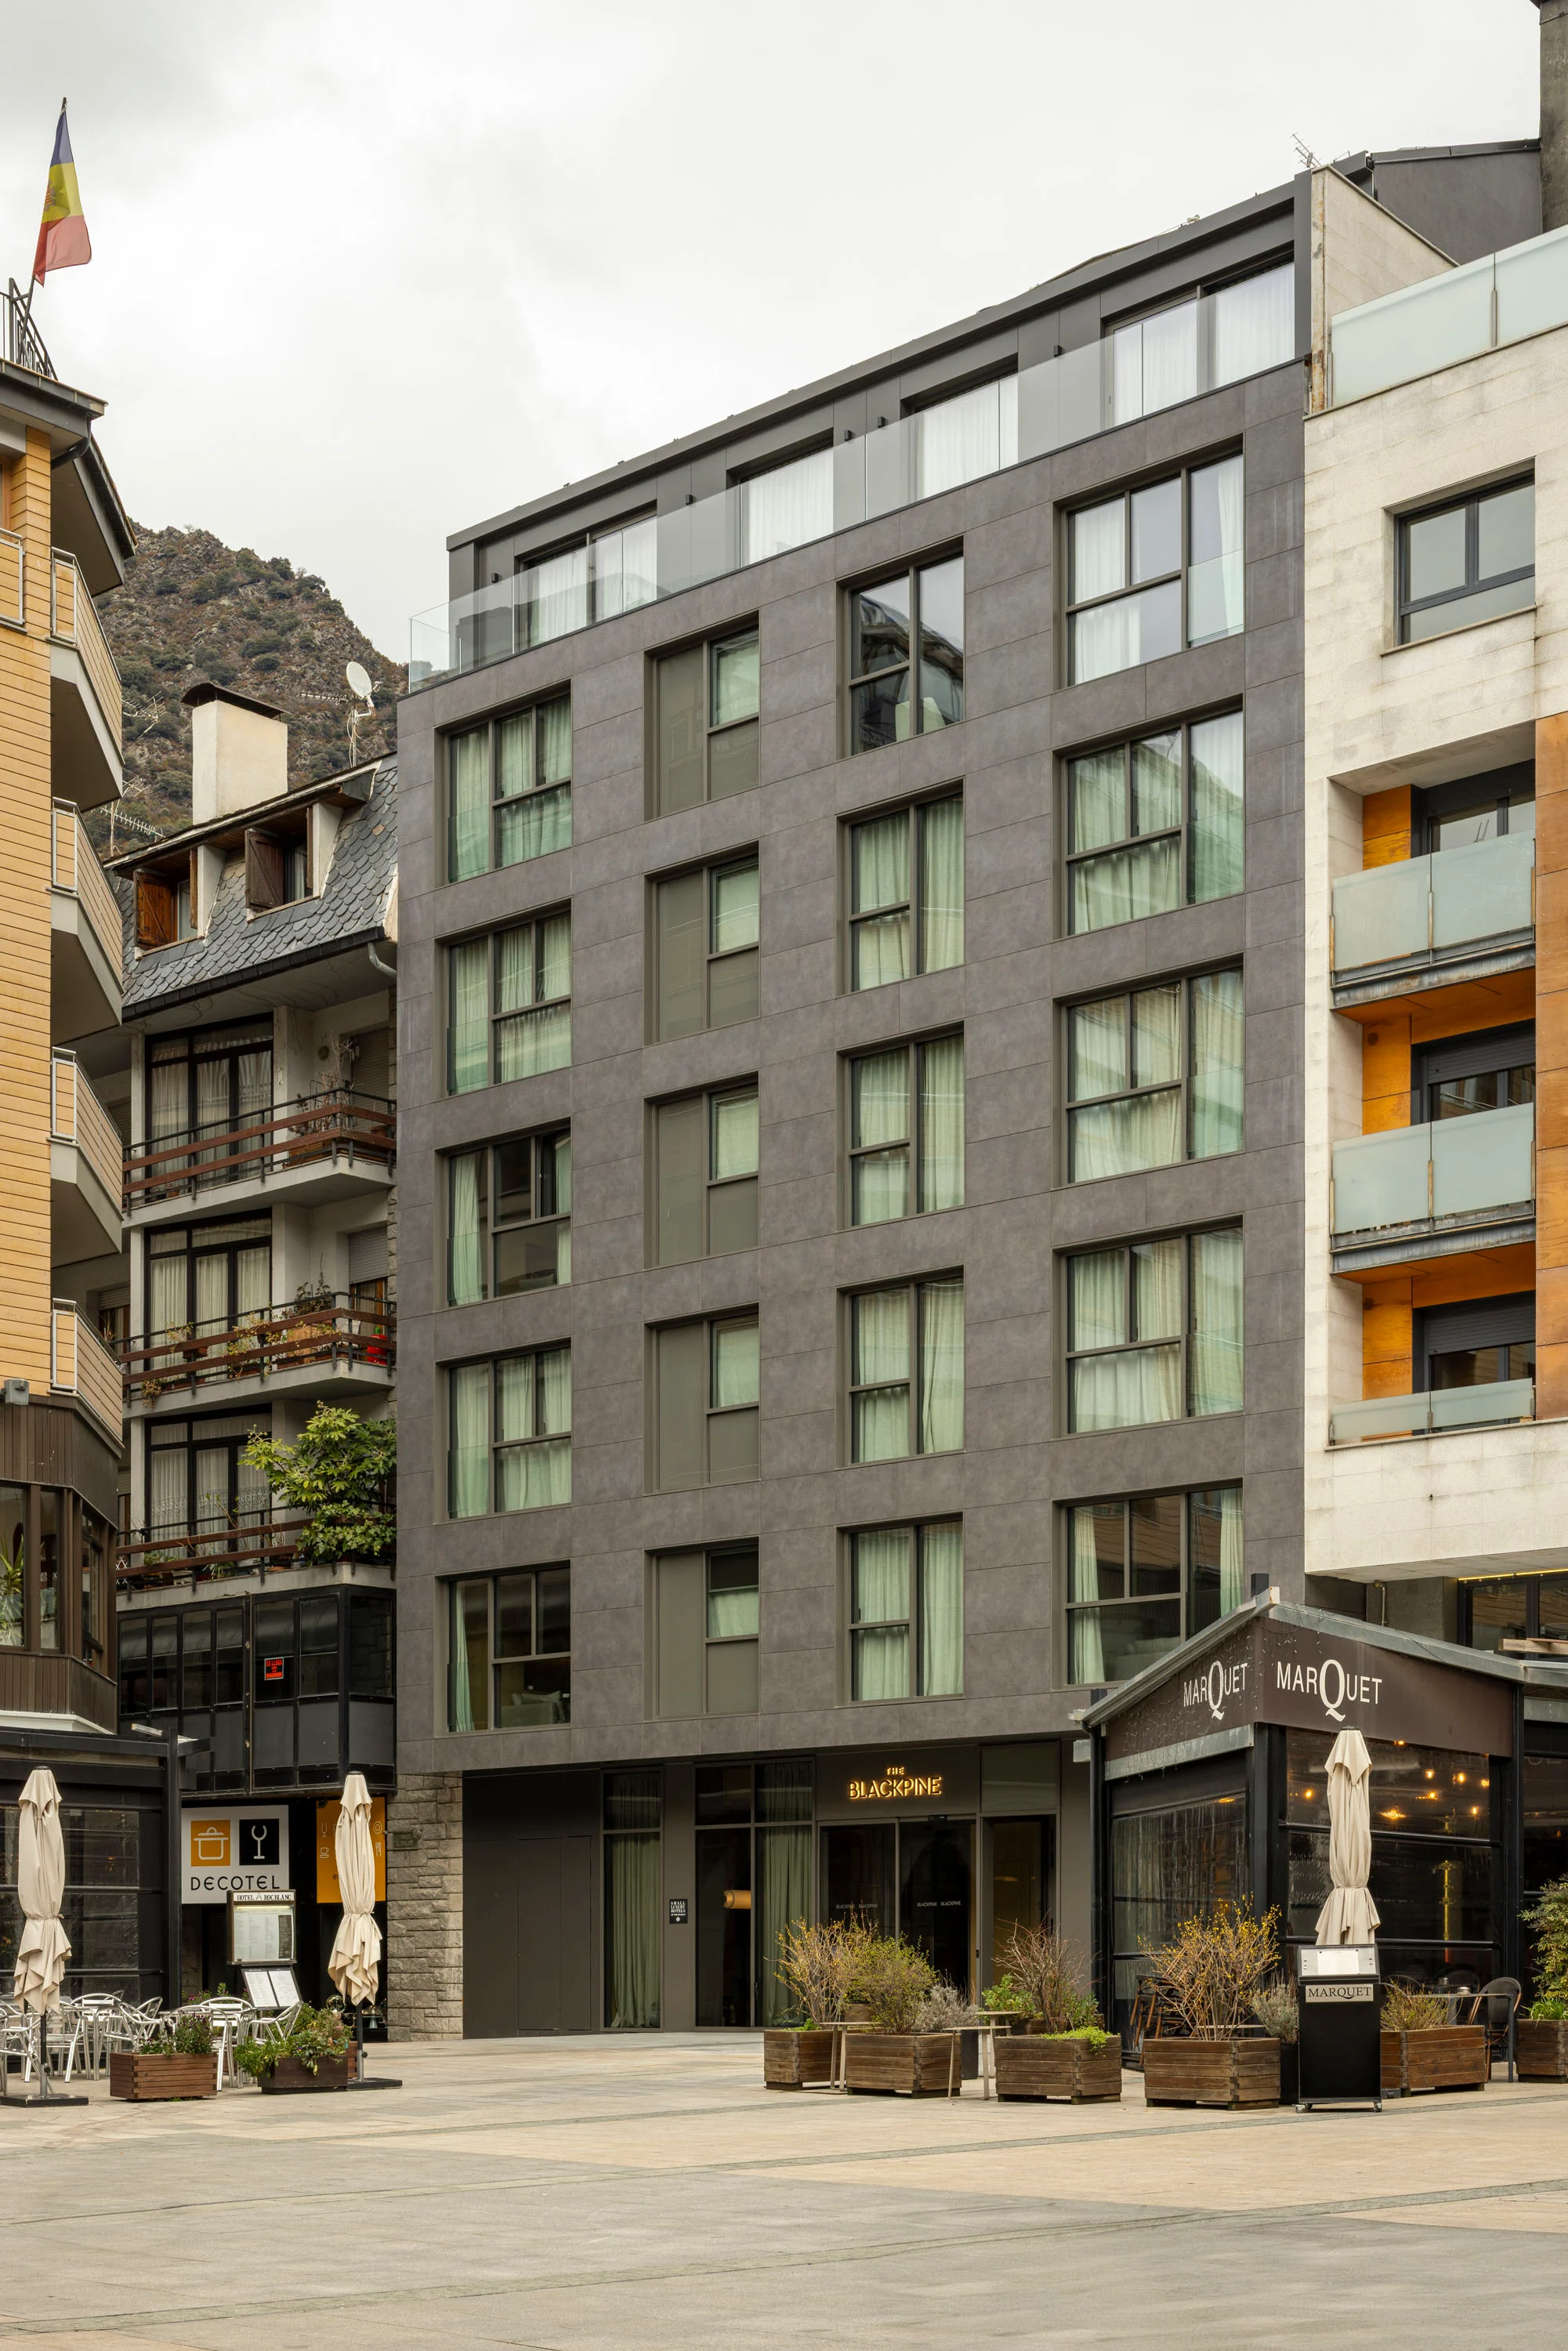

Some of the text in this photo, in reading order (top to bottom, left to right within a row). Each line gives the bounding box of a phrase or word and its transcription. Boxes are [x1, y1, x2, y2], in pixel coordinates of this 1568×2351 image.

[1183, 1661, 1248, 1720] MARQUET
[1276, 1659, 1383, 1722] MARQUET
[887, 1767, 905, 1776] THE
[849, 1777, 942, 1799] BLACKPINE
[190, 1875, 280, 1890] DECOTEL
[1308, 1987, 1371, 2000] MARQUET
